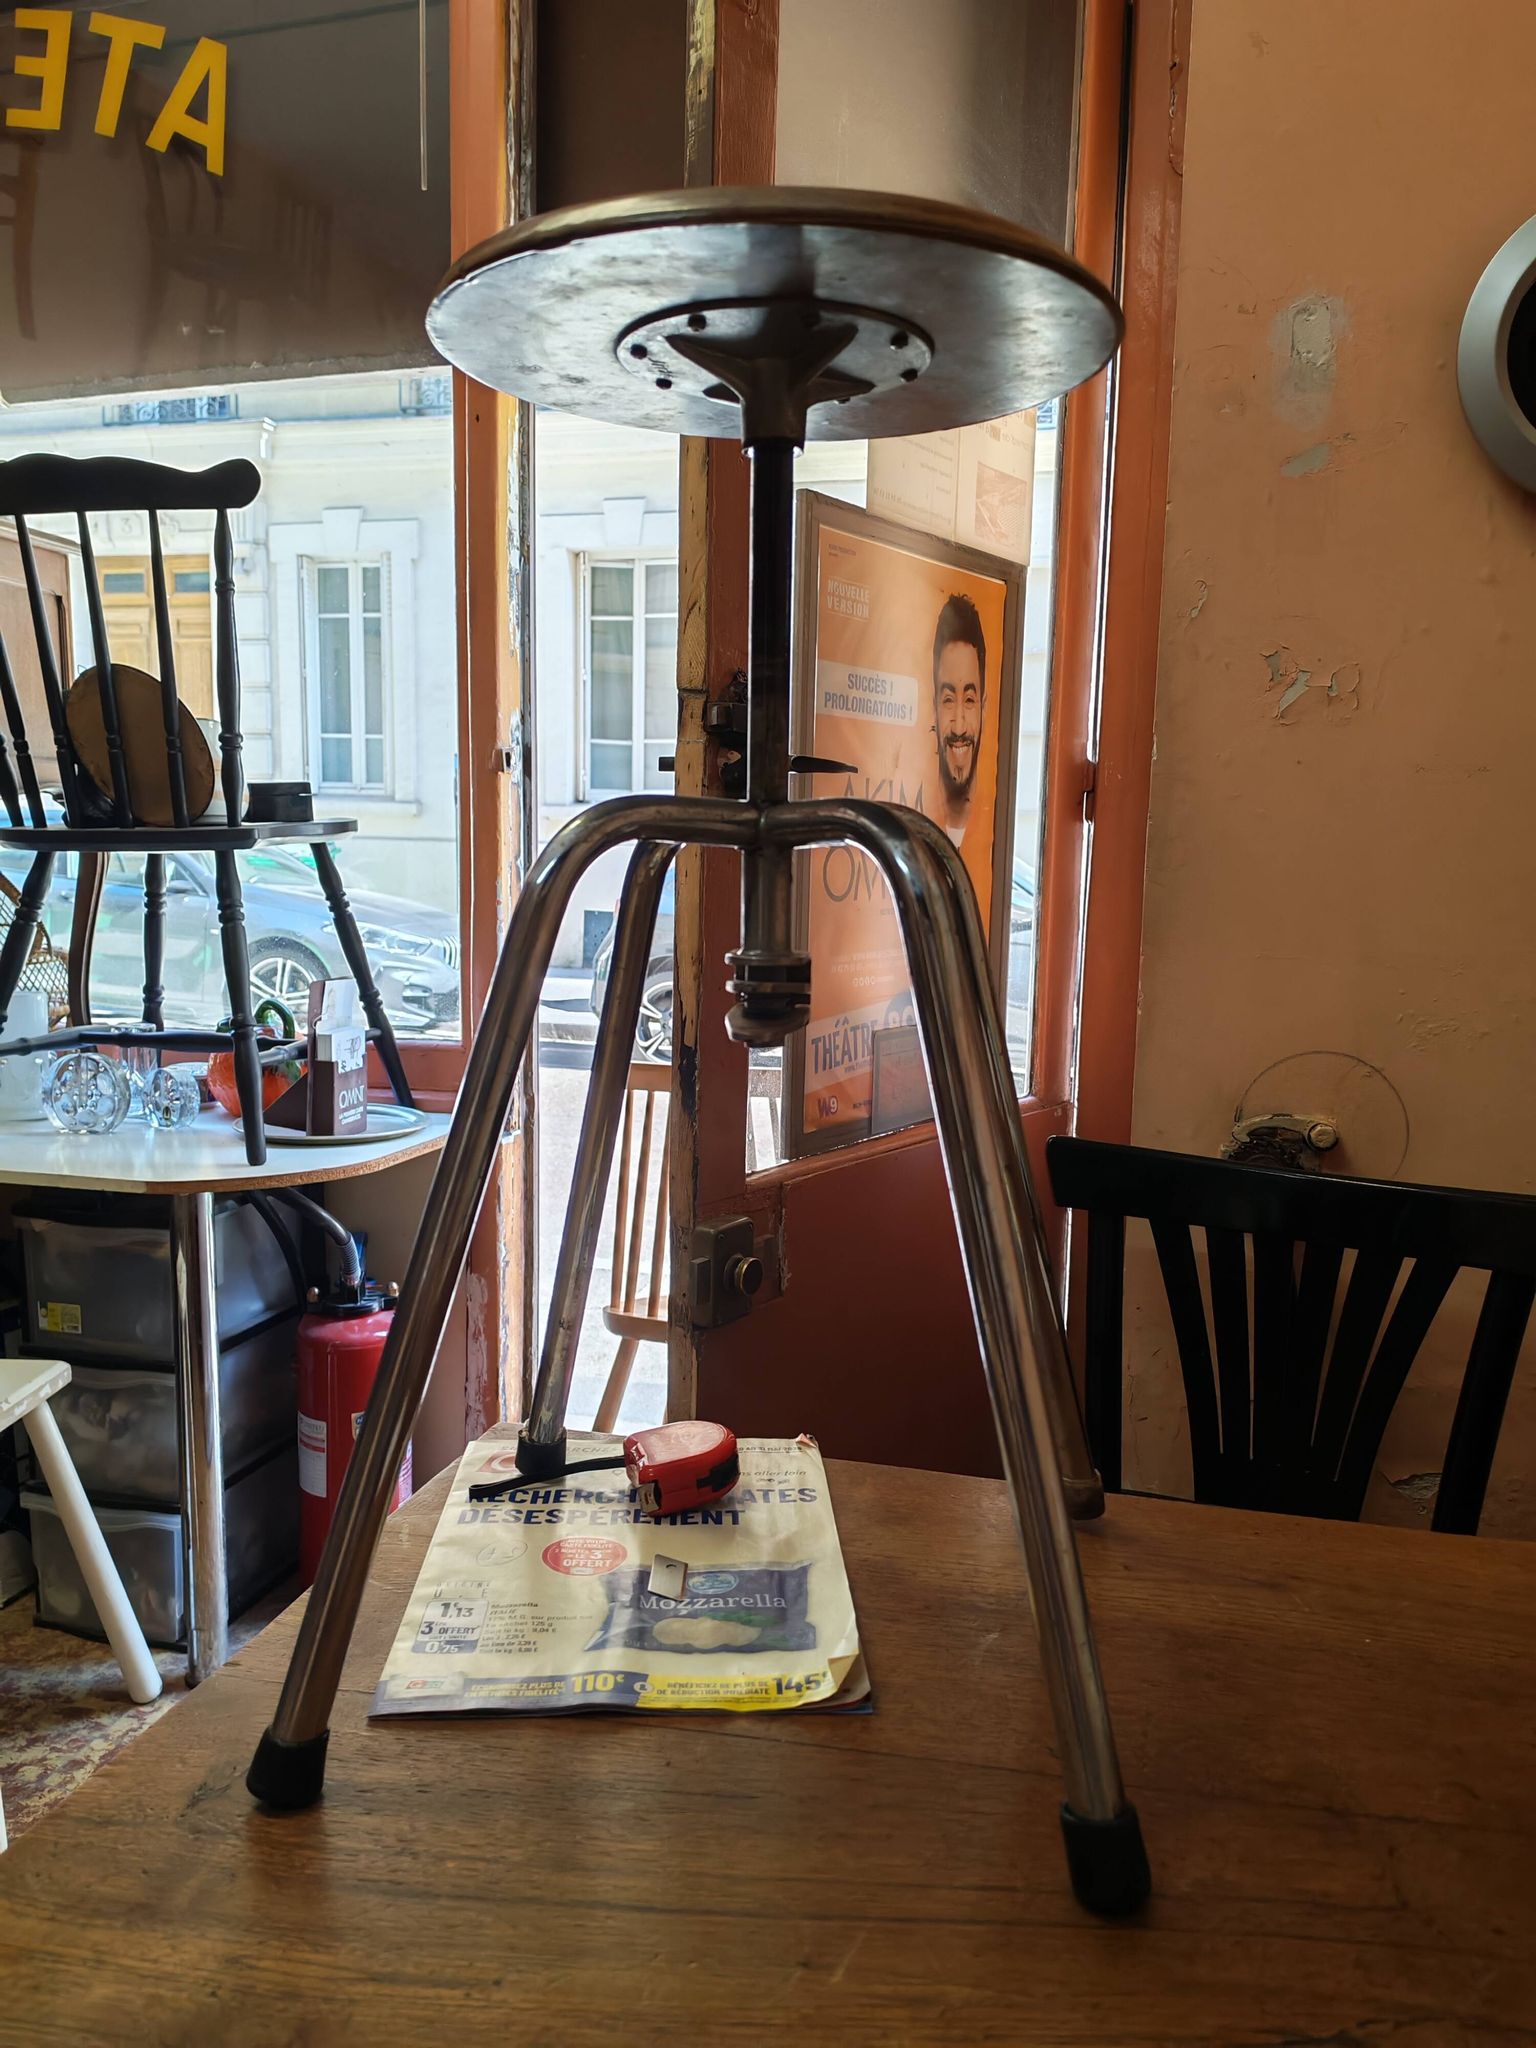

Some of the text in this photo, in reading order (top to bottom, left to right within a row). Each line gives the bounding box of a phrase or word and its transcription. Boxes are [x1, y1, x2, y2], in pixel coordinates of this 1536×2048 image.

[827, 579, 870, 603] NOUVELLE
[826, 595, 870, 617] VERSION
[824, 691, 906, 720] PROLONGATIONS
[811, 1016, 876, 1074] THÉÂTR
[465, 1488, 638, 1505] ECHERCH
[562, 1559, 613, 1567] OFFERT
[639, 1594, 788, 1615] Mozzarella
[438, 1627, 475, 1635] OFFERT
